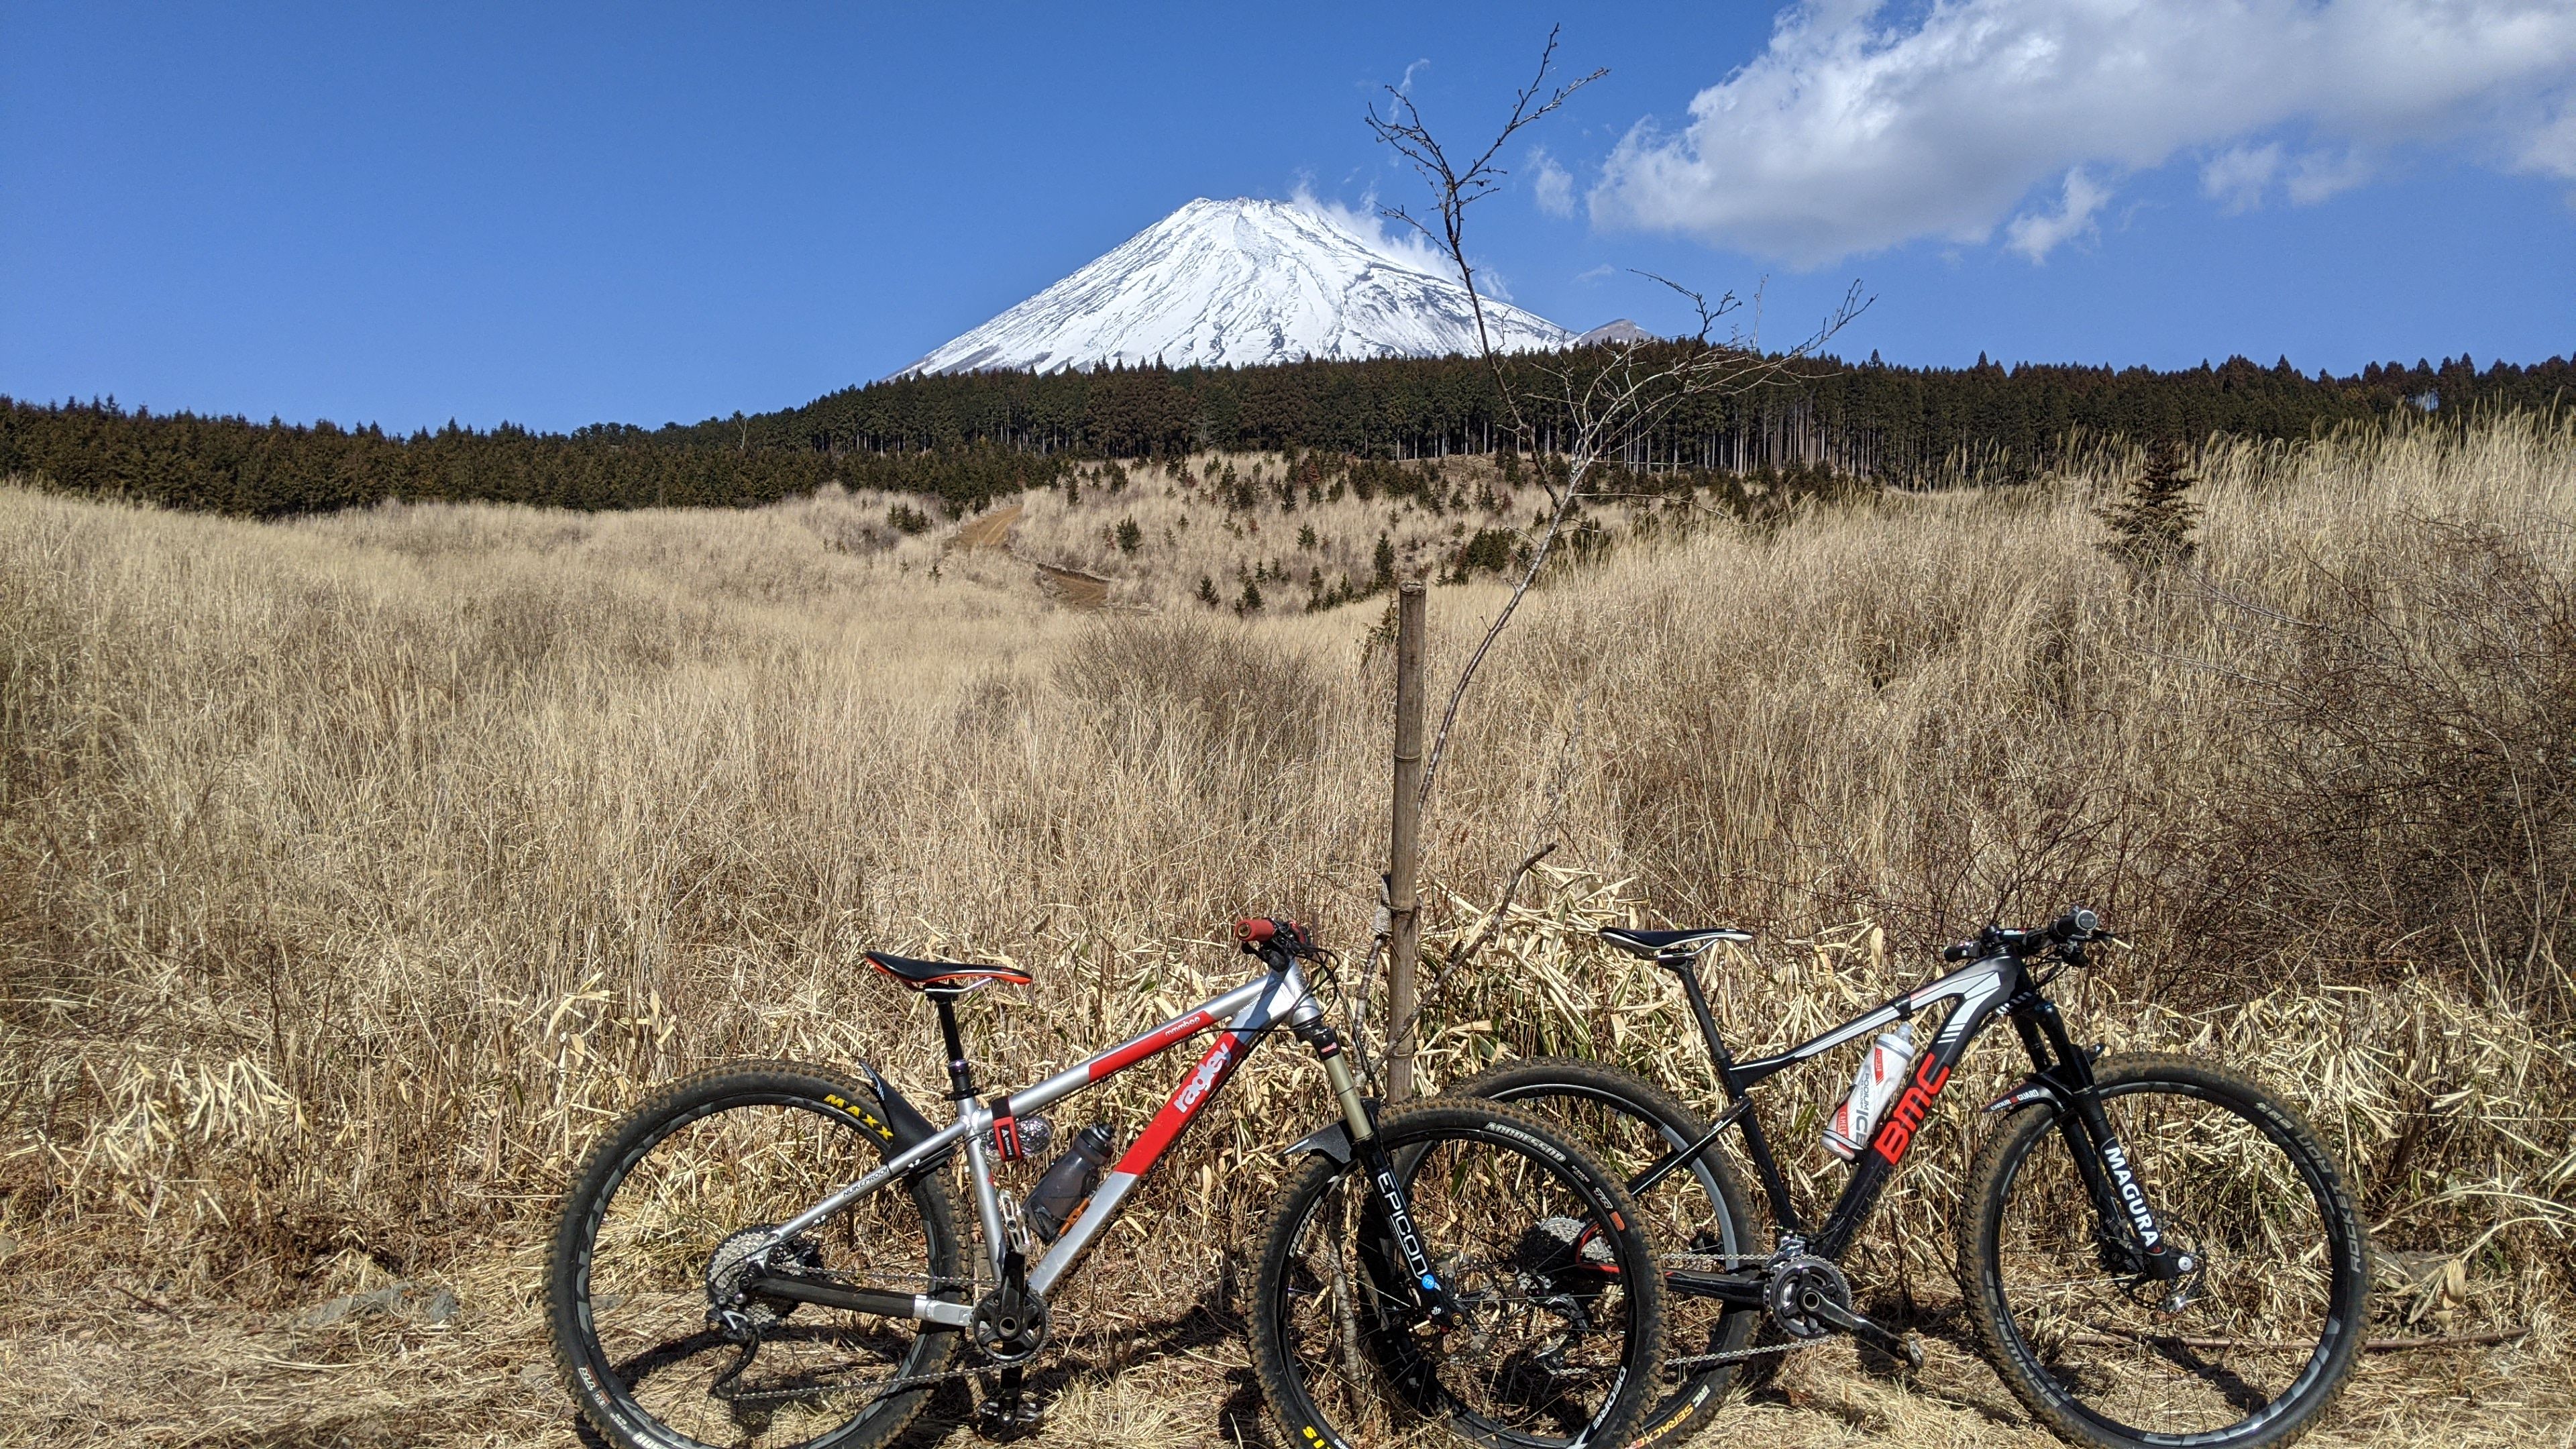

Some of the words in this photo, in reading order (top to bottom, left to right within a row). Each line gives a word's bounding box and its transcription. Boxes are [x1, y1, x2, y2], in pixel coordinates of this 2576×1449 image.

[1174, 1042, 1231, 1113] ragley
[2017, 1089, 2039, 1101] GUARD
[1856, 1109, 1869, 1147] ICE
[1874, 1052, 1951, 1165] BMC
[1483, 1121, 1567, 1163] AGGRESSOR
[2294, 1134, 2332, 1173] RON
[1594, 1187, 1613, 1209] TR
[2104, 1146, 2159, 1247] MAGURA
[1289, 1195, 1324, 1258] DEORE
[1377, 1171, 1429, 1275] EPICON
[2329, 1181, 2361, 1274] ROCKET
[1986, 1269, 2061, 1408] SCHWALBE
[578, 1367, 596, 1391] TR
[594, 1392, 606, 1409] EXO
[1593, 1365, 1627, 1430] DEORE
[1654, 1402, 1694, 1440] SERAC
